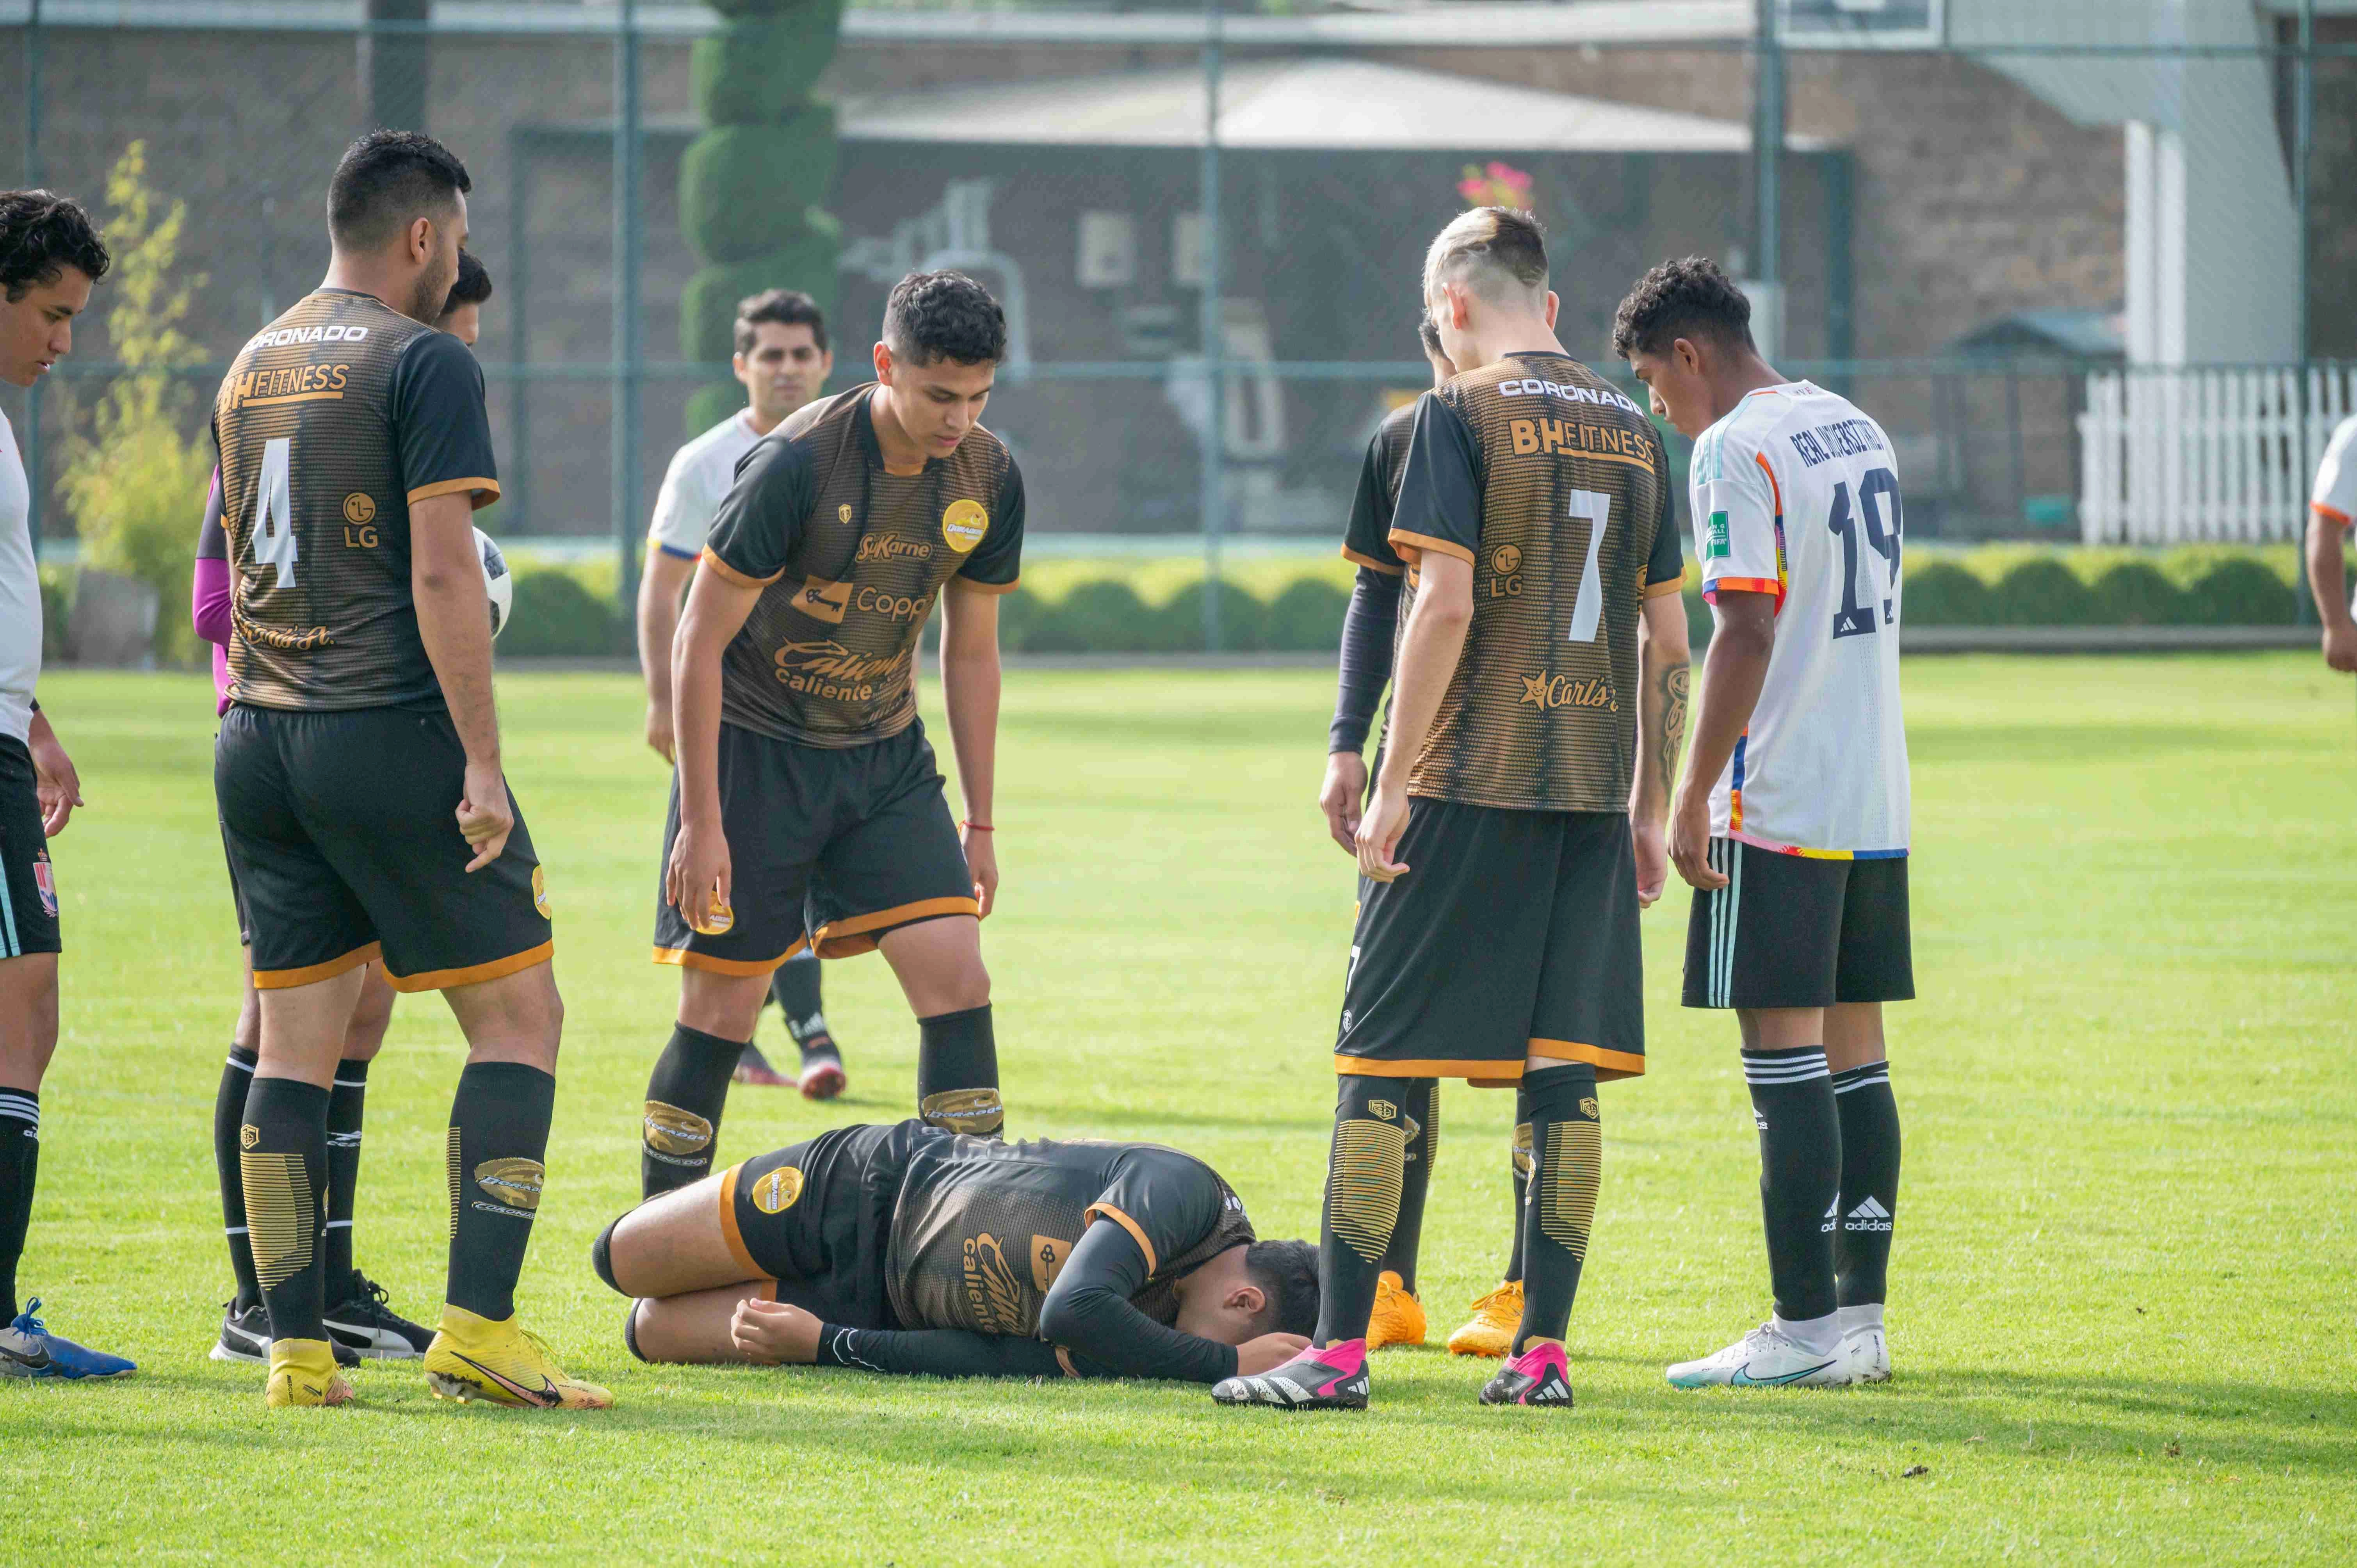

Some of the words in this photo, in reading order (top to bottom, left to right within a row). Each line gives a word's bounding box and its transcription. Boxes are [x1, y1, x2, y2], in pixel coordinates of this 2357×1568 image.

[244, 326, 368, 352] ORONADO
[1499, 379, 1644, 418] CORONADO
[1789, 430, 1830, 468] REAL
[252, 438, 298, 588] 4
[344, 526, 378, 548] LG
[858, 534, 930, 560] SuKarne
[1828, 467, 1902, 639] 19
[1569, 489, 1611, 642] 7
[1491, 575, 1522, 598] LG
[775, 668, 872, 701] caliente
[1547, 675, 1610, 708] Carl's
[1346, 945, 1361, 993] 7
[475, 1203, 535, 1219] CORONA
[1845, 1219, 1892, 1231] adidas
